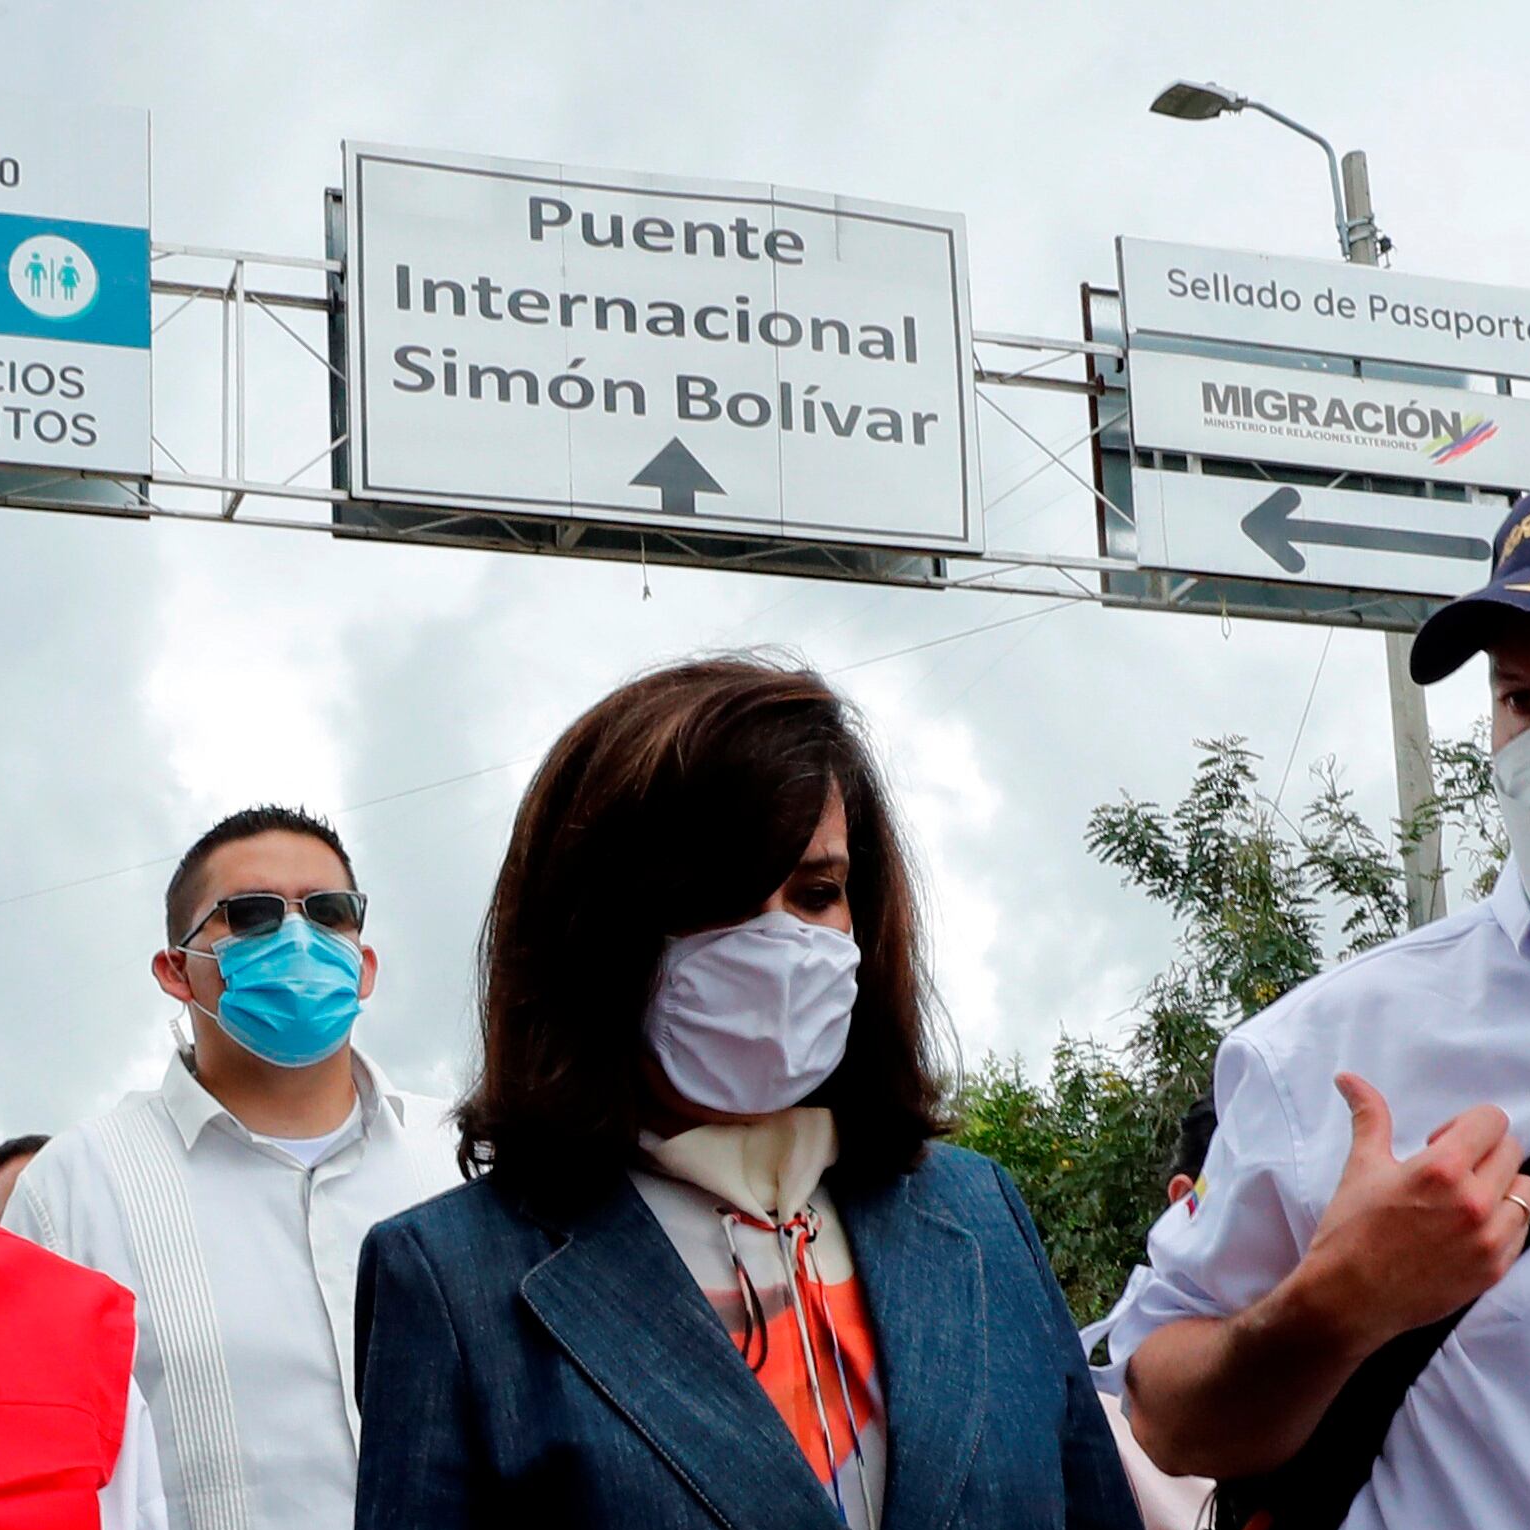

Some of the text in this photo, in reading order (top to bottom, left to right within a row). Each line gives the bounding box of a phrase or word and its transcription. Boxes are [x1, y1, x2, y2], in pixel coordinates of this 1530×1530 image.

[529, 196, 805, 265] Puente
[395, 264, 918, 364] Internacional
[1167, 268, 1301, 312] Sellado
[1313, 288, 1357, 319] de
[393, 344, 940, 446] Simón Bolívar
[1201, 381, 1464, 441] MIGRACIÓN
[1203, 417, 1418, 451] MINISTERIO DE RELACIONES EXTERIORES
